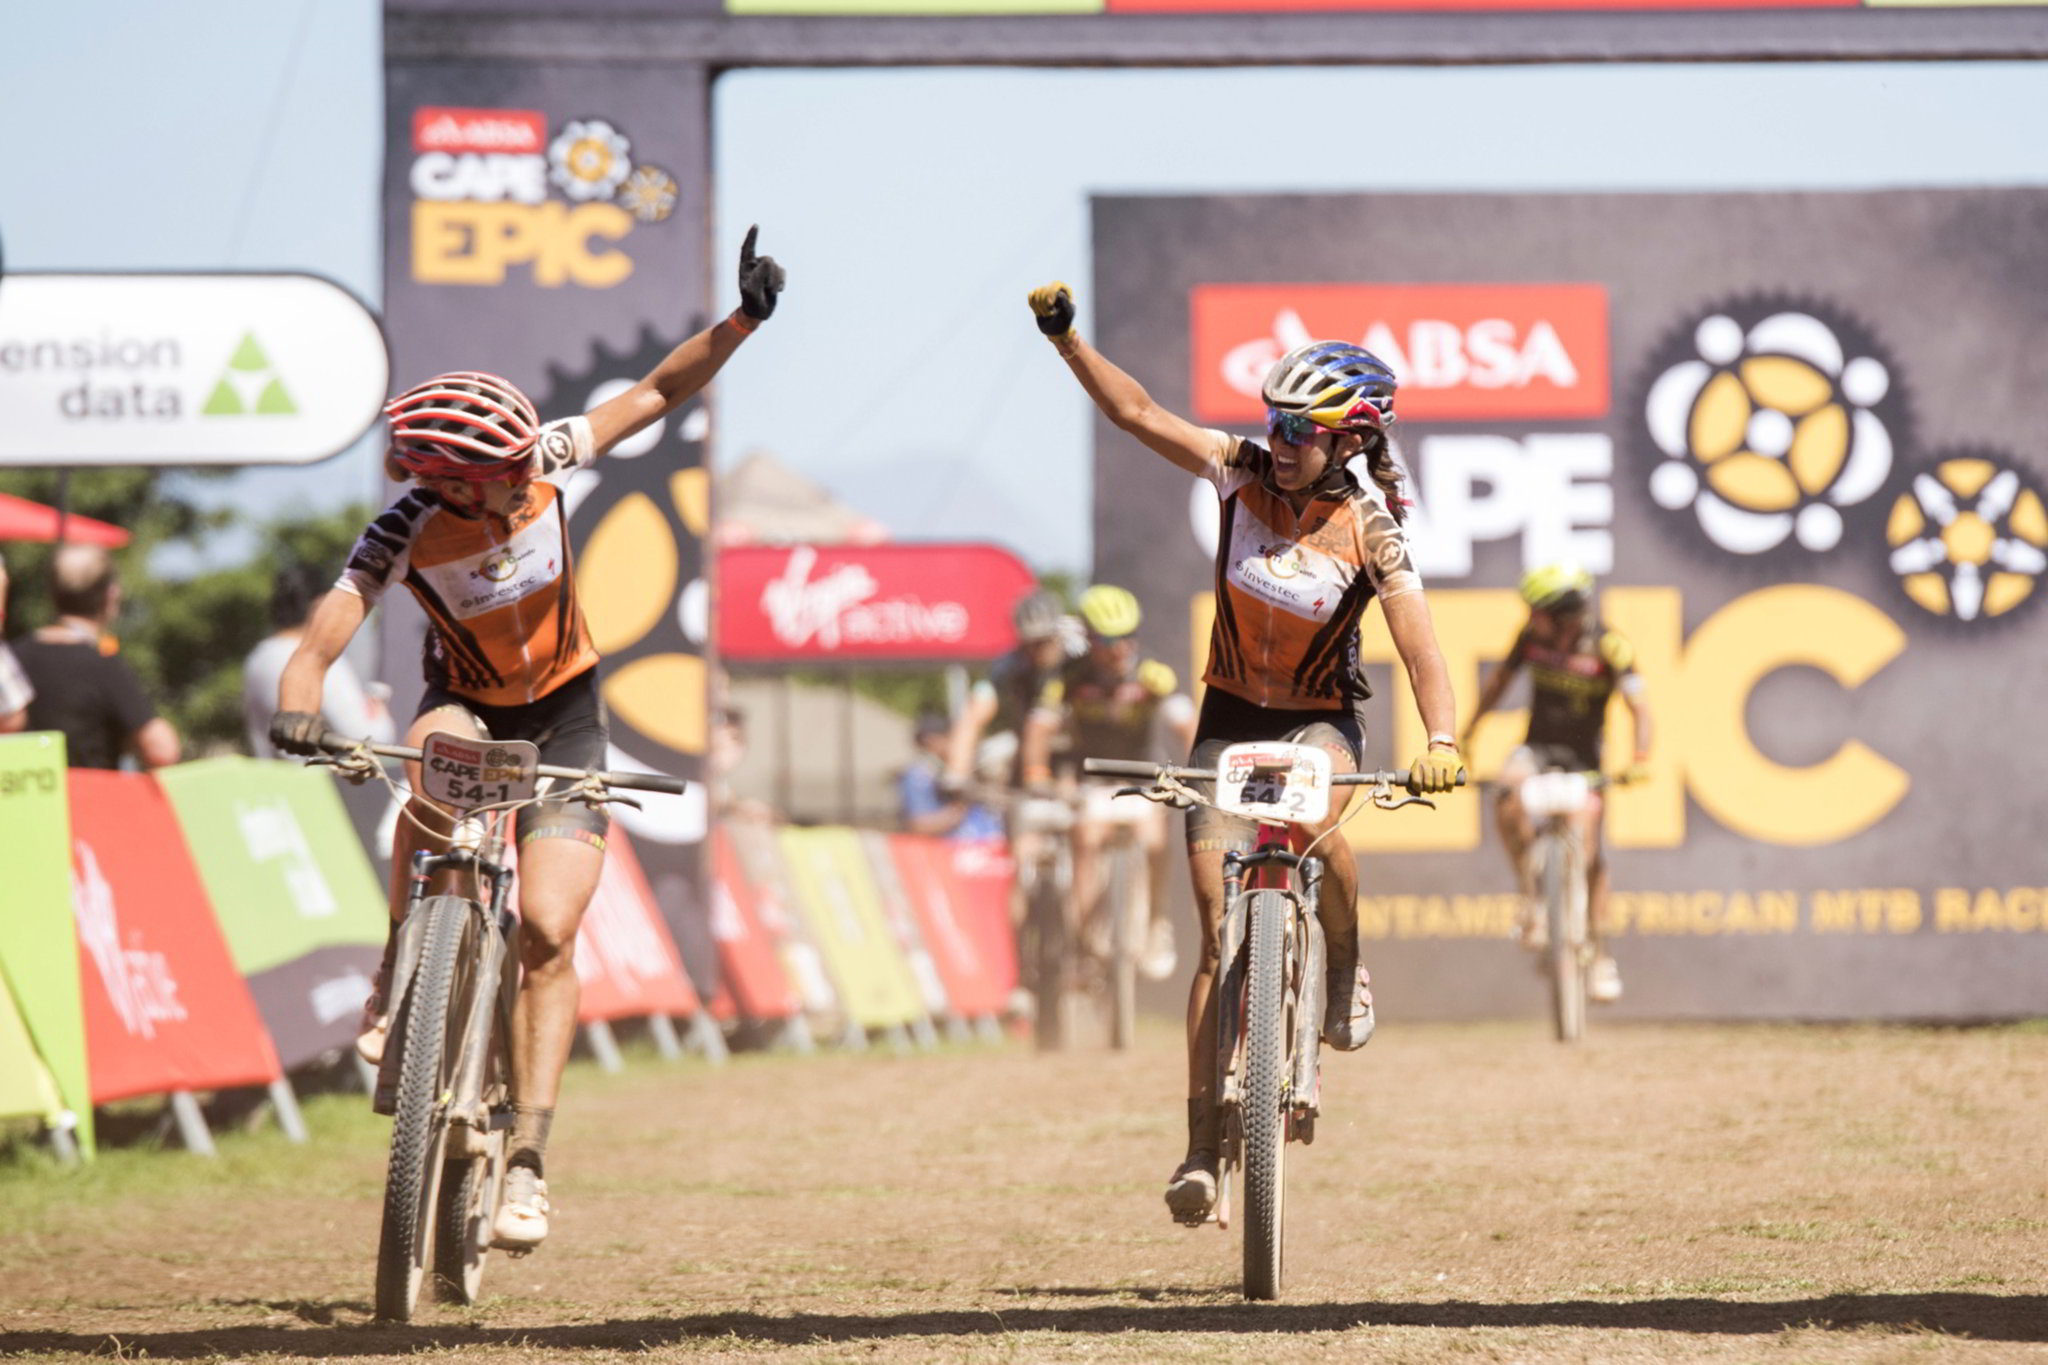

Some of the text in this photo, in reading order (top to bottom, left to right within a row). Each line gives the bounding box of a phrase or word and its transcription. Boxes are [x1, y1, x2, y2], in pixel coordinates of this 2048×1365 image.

[410, 152, 548, 205] CAPE
[411, 199, 635, 287] EPIC
[0, 329, 181, 371] ension
[1360, 317, 1578, 388] ABSA
[59, 376, 182, 418] data
[845, 596, 969, 643] active
[430, 757, 481, 781] CAPE
[447, 778, 509, 803] 54-1
[1240, 786, 1306, 812] 54-2
[1357, 893, 1520, 941] NTAME
[1604, 890, 1797, 937] FRICAN
[1811, 888, 1921, 935] MTB
